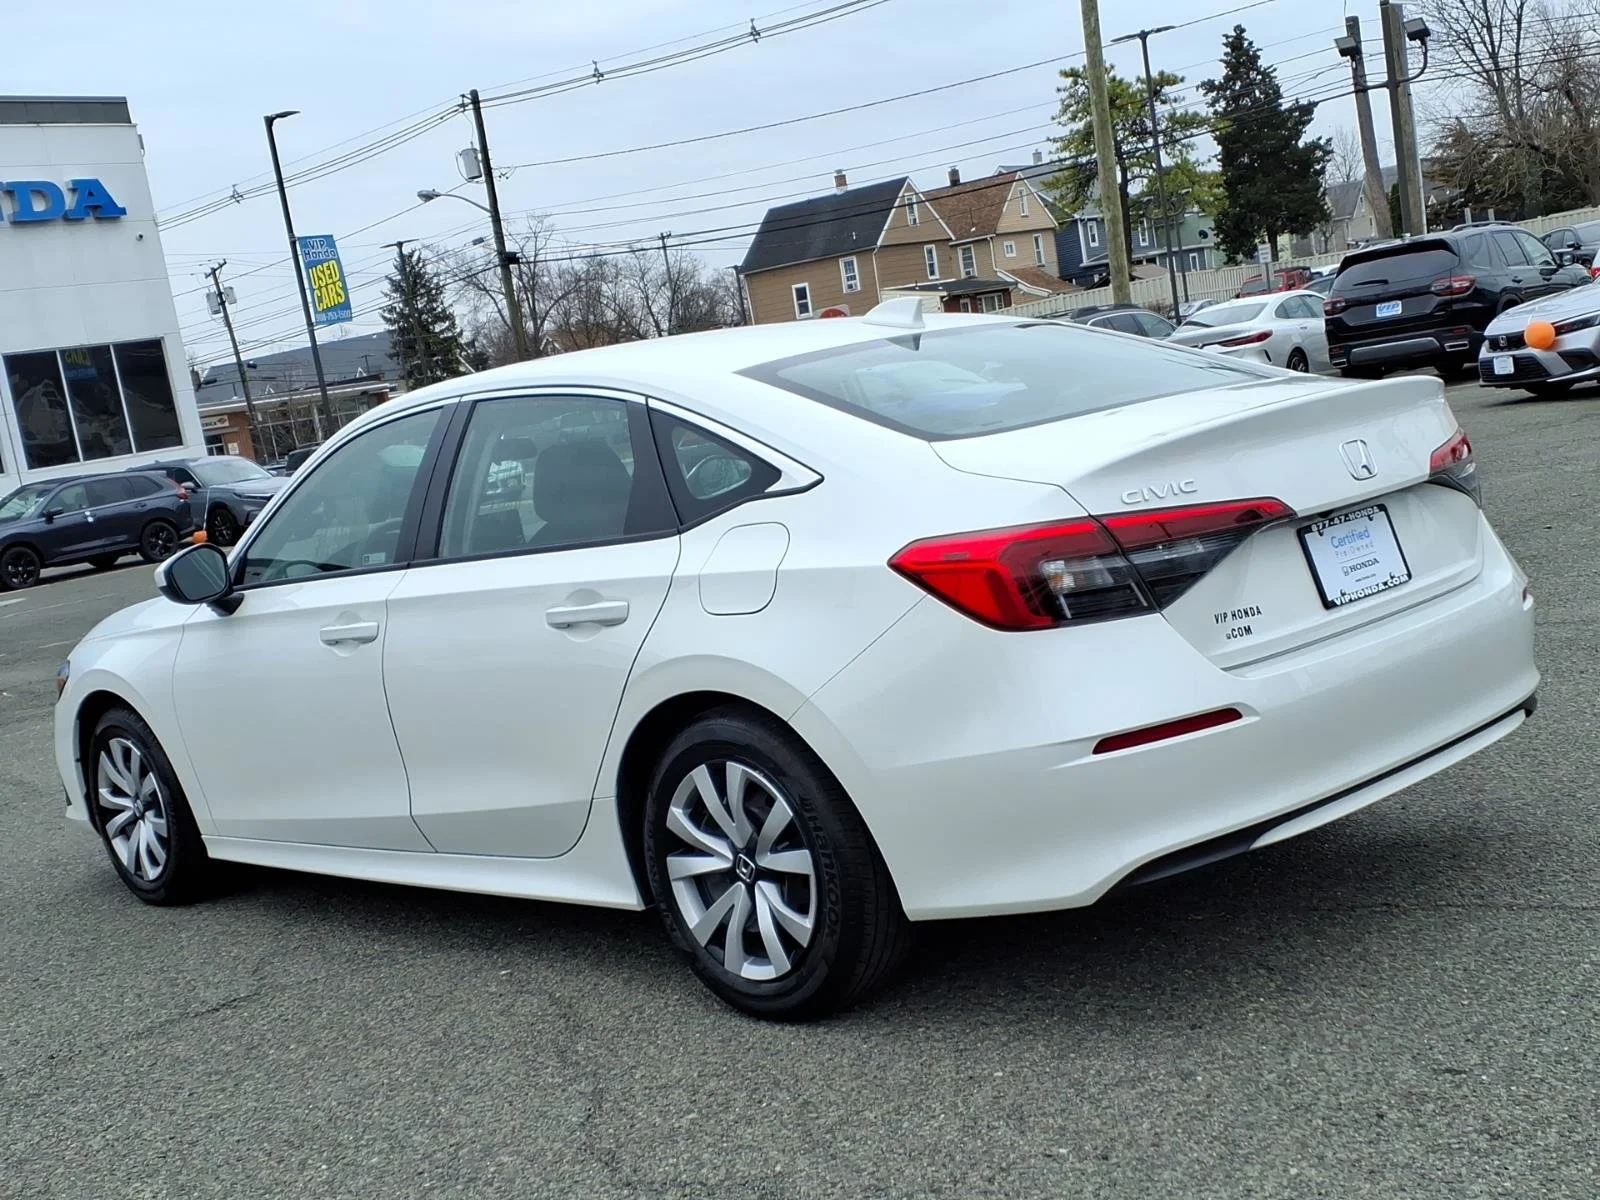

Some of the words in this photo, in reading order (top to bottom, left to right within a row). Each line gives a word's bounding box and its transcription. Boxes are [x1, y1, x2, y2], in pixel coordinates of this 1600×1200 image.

[0, 178, 127, 223] DA
[303, 248, 337, 260] Honda
[307, 239, 326, 250] VIP
[308, 259, 340, 289] USED
[313, 281, 345, 311] CARS
[1121, 479, 1198, 505] CIVIC
[1311, 506, 1380, 532] 877-47-HONDA
[1330, 528, 1370, 549] Certified
[1349, 557, 1380, 573] HONDA
[1333, 574, 1410, 606] VIPHONDA.COM
[1214, 611, 1228, 624] VIP
[1230, 605, 1262, 621] HONDA
